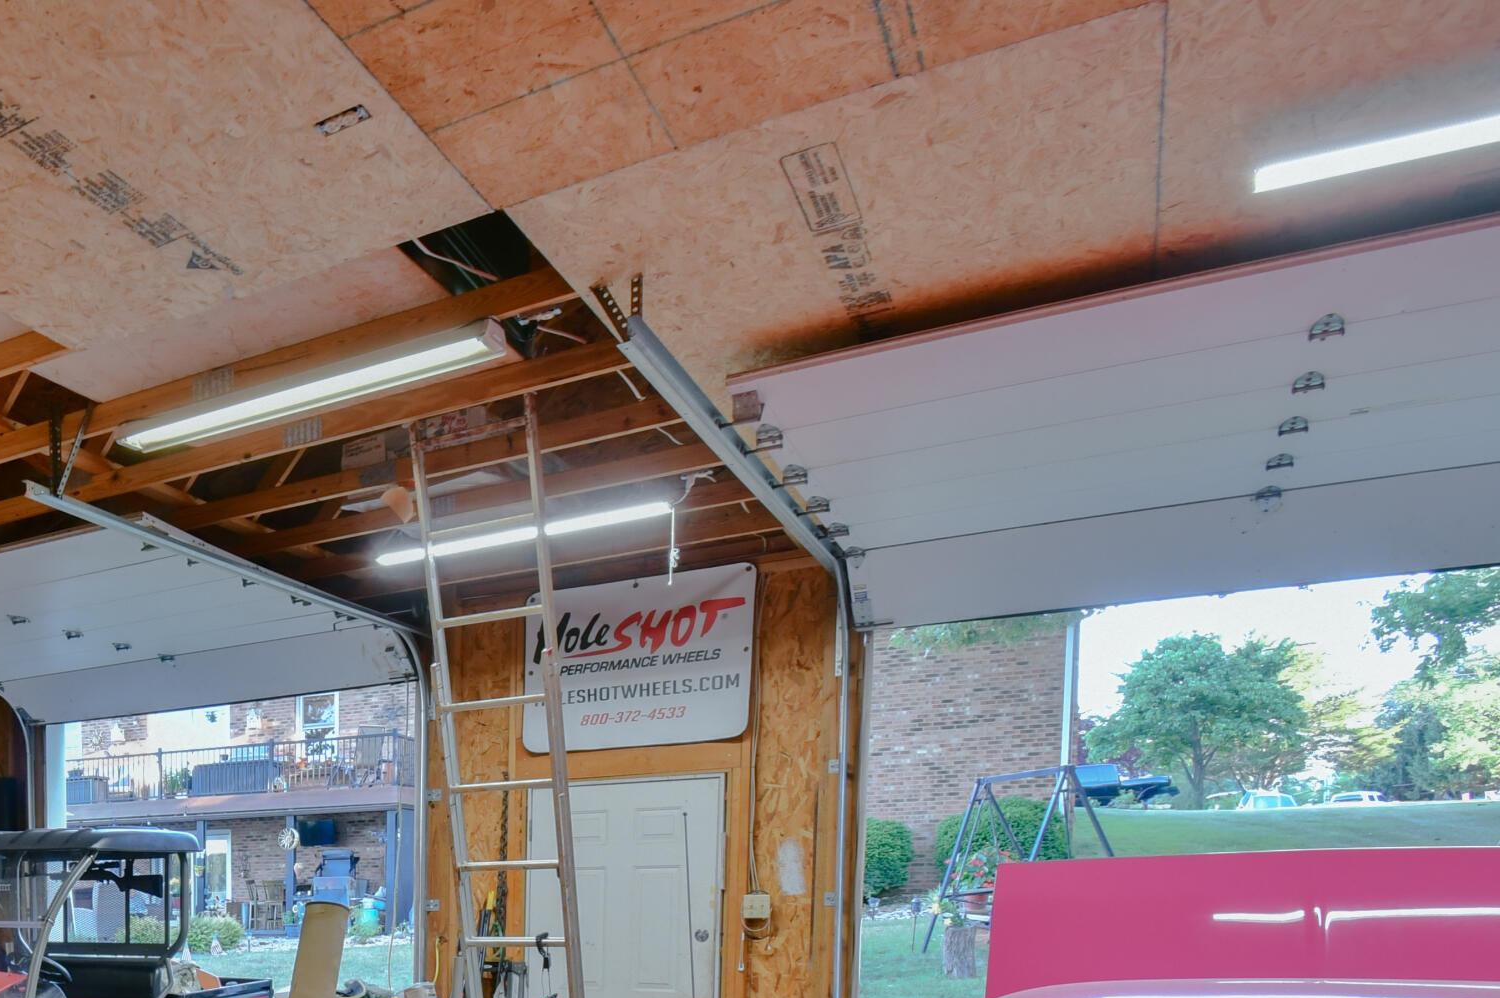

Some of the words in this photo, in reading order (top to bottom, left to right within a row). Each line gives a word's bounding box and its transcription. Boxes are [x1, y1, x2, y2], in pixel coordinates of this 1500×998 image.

[559, 655, 658, 677] PERFORMANCE
[662, 648, 722, 666] WHEELS
[534, 673, 741, 707] LESHOTWHEELS.COM
[579, 705, 687, 727] 800-372-4533
